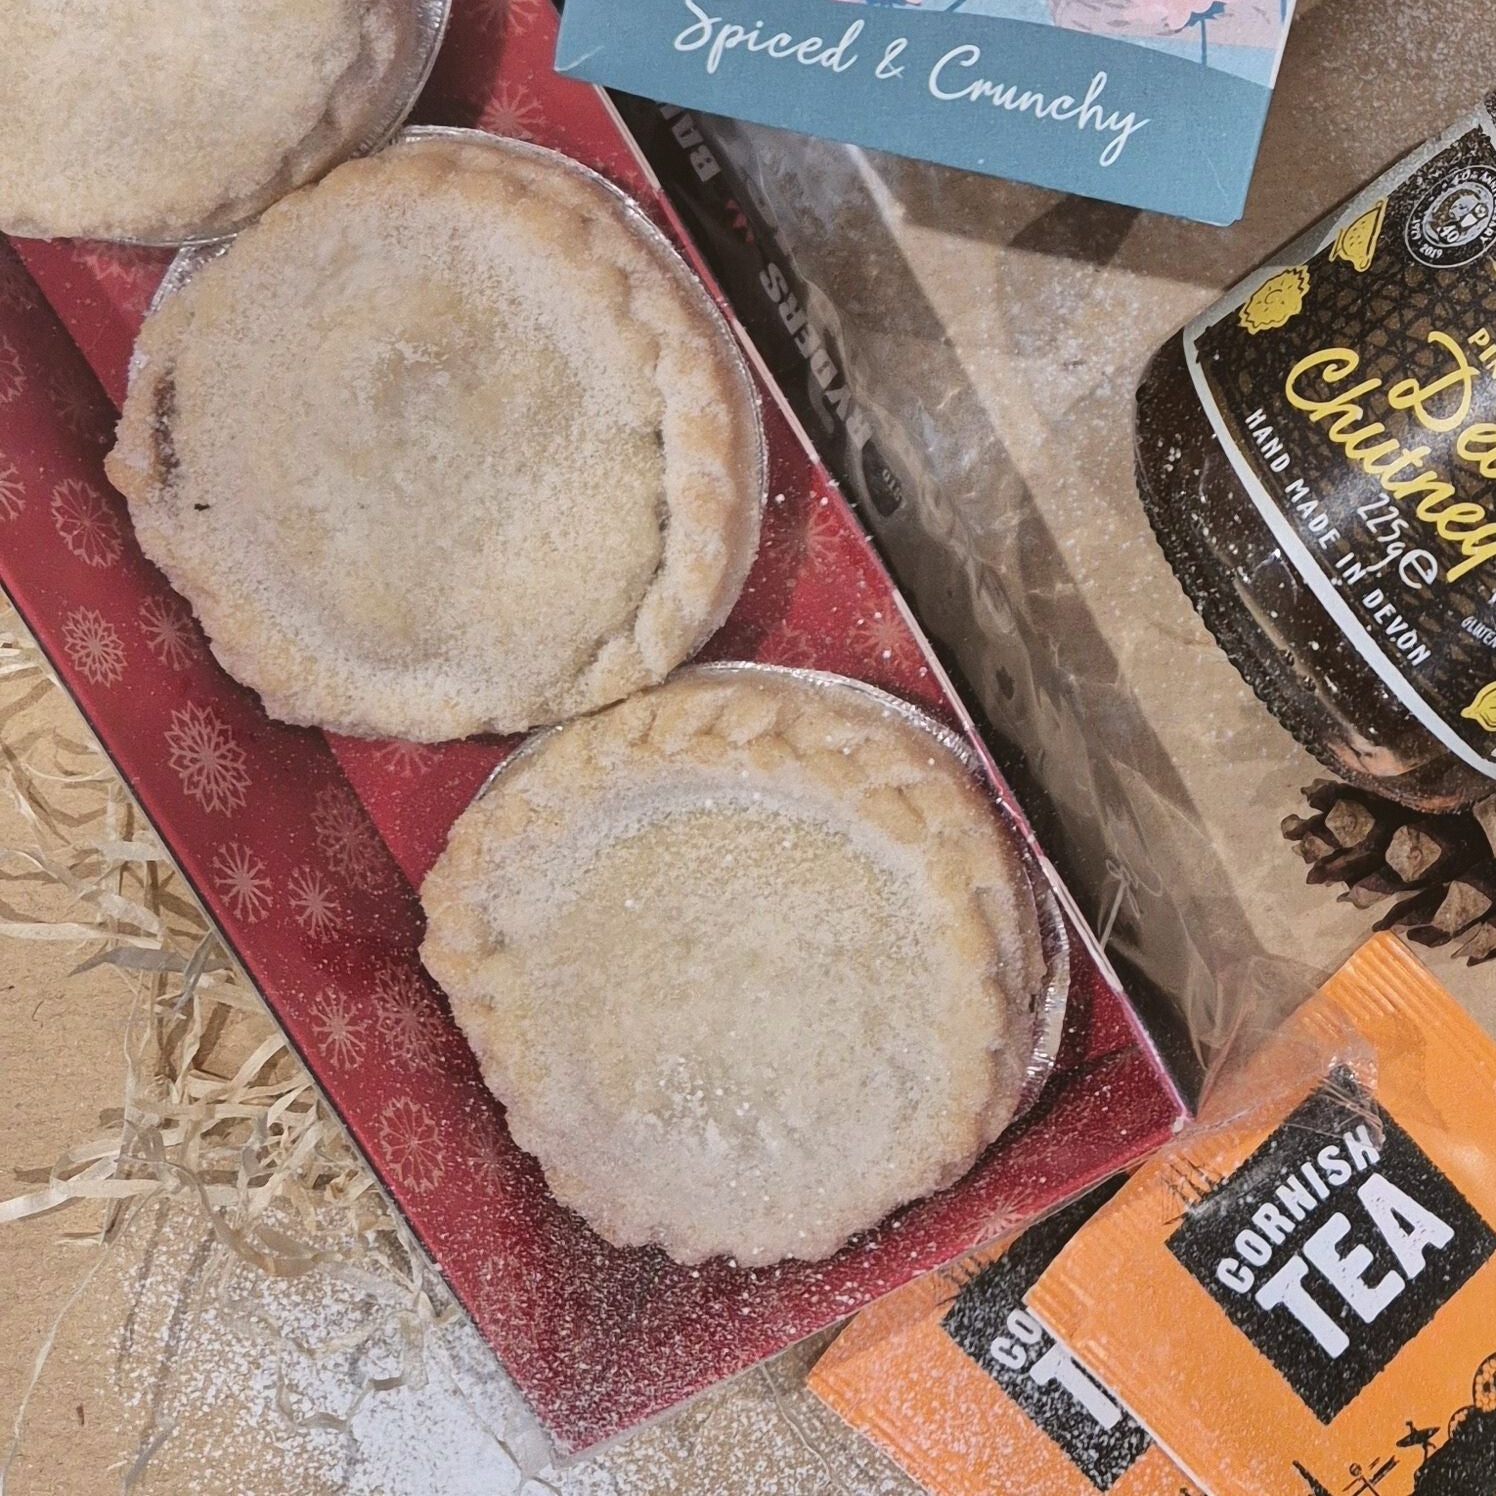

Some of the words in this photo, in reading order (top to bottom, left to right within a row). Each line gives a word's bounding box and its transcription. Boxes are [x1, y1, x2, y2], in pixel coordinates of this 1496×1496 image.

[875, 37, 908, 80] &
[928, 44, 1151, 166] Crunchy
[1420, 244, 1443, 259] 2019
[1244, 408, 1291, 474] HAND
[1284, 478, 1340, 550] MADE
[1334, 551, 1367, 586] IN
[1362, 588, 1431, 667] DEVON
[1215, 1124, 1381, 1294] CORNISH
[1255, 1172, 1455, 1359] TEA
